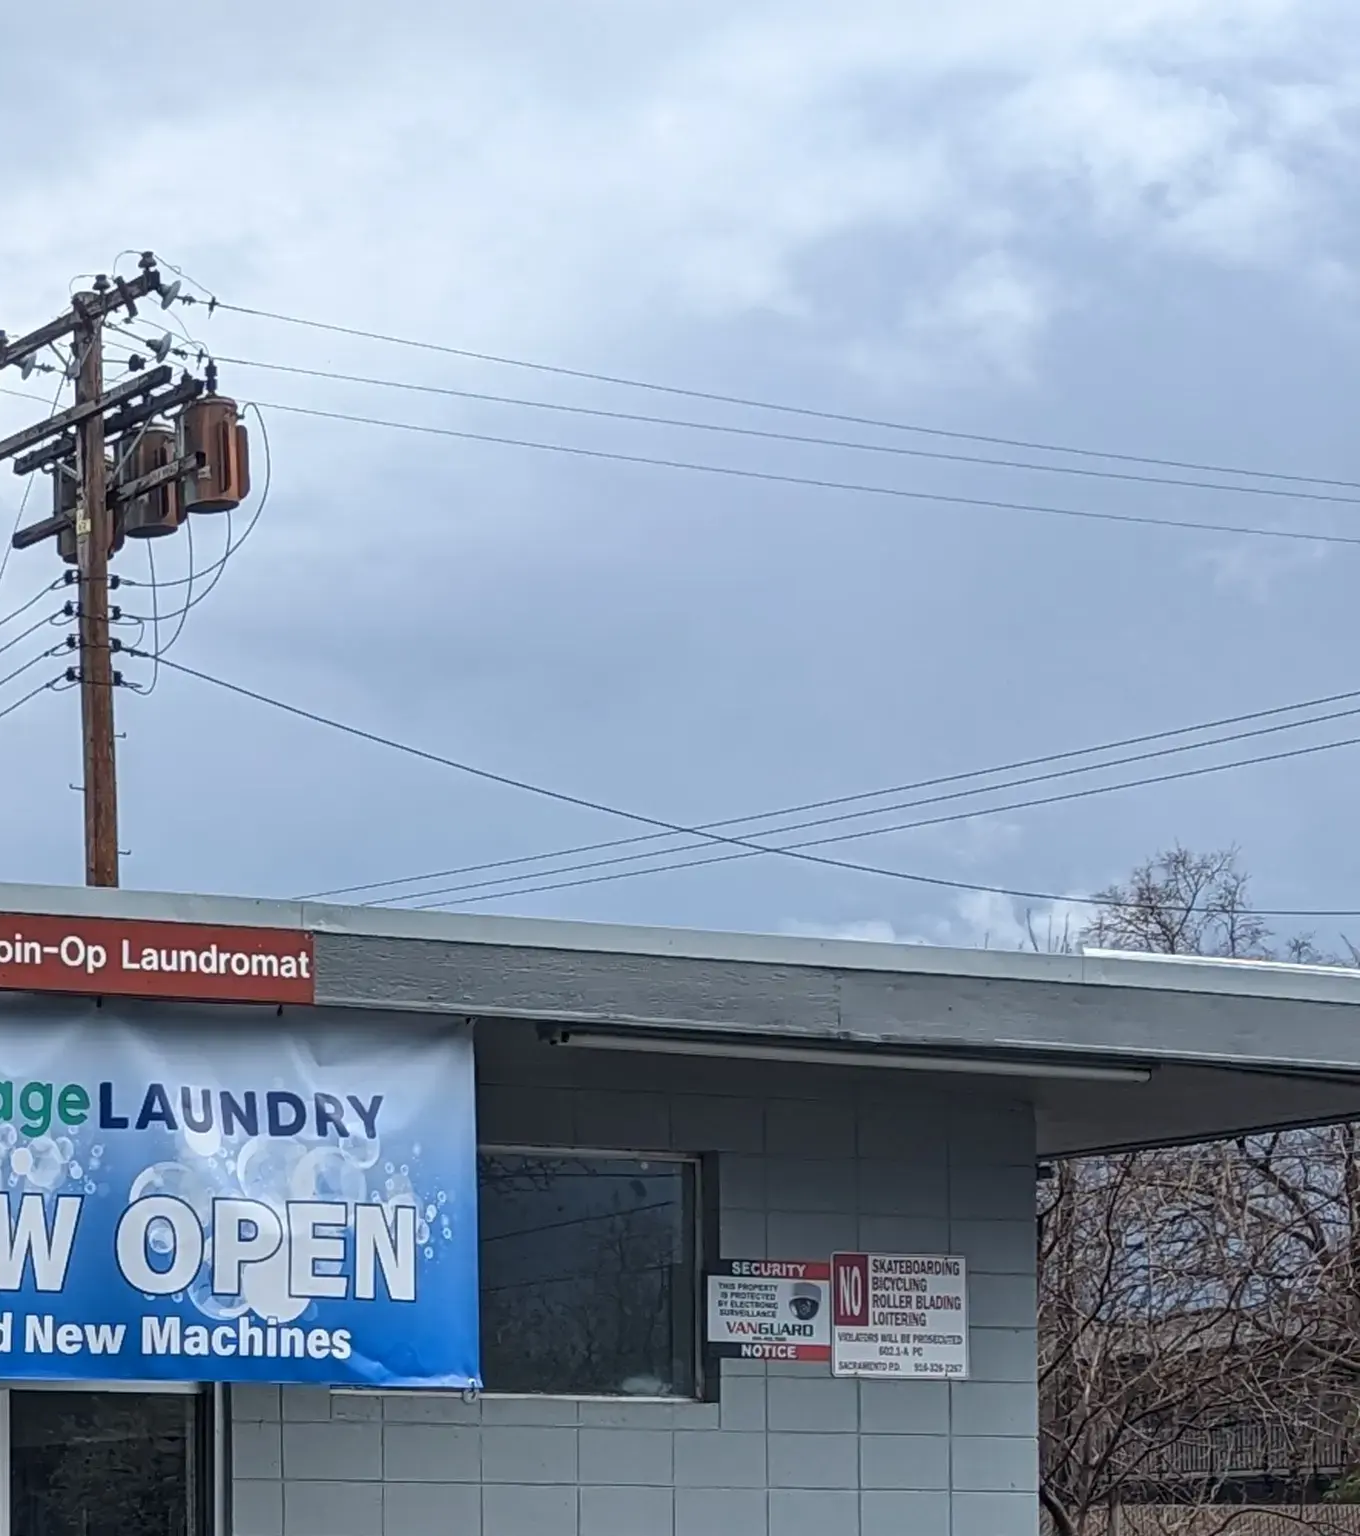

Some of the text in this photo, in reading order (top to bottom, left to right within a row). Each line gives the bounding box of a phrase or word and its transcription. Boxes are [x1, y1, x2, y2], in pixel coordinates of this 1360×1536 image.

[122, 938, 312, 978] Laundromat
[114, 1194, 418, 1302] OPEN
[732, 1261, 806, 1277] SECURITY
[872, 1259, 960, 1276] SKATEBOARDING
[839, 1266, 862, 1316] NO
[872, 1277, 927, 1292] BICYCLING
[872, 1294, 961, 1310] ROLLER BLADING
[872, 1311, 927, 1326] LOITERING
[24, 1314, 126, 1356] New
[140, 1315, 353, 1360] Machines
[726, 1321, 814, 1337] VANGUARD
[741, 1344, 797, 1358] NOTICE
[912, 1347, 923, 1356] PC
